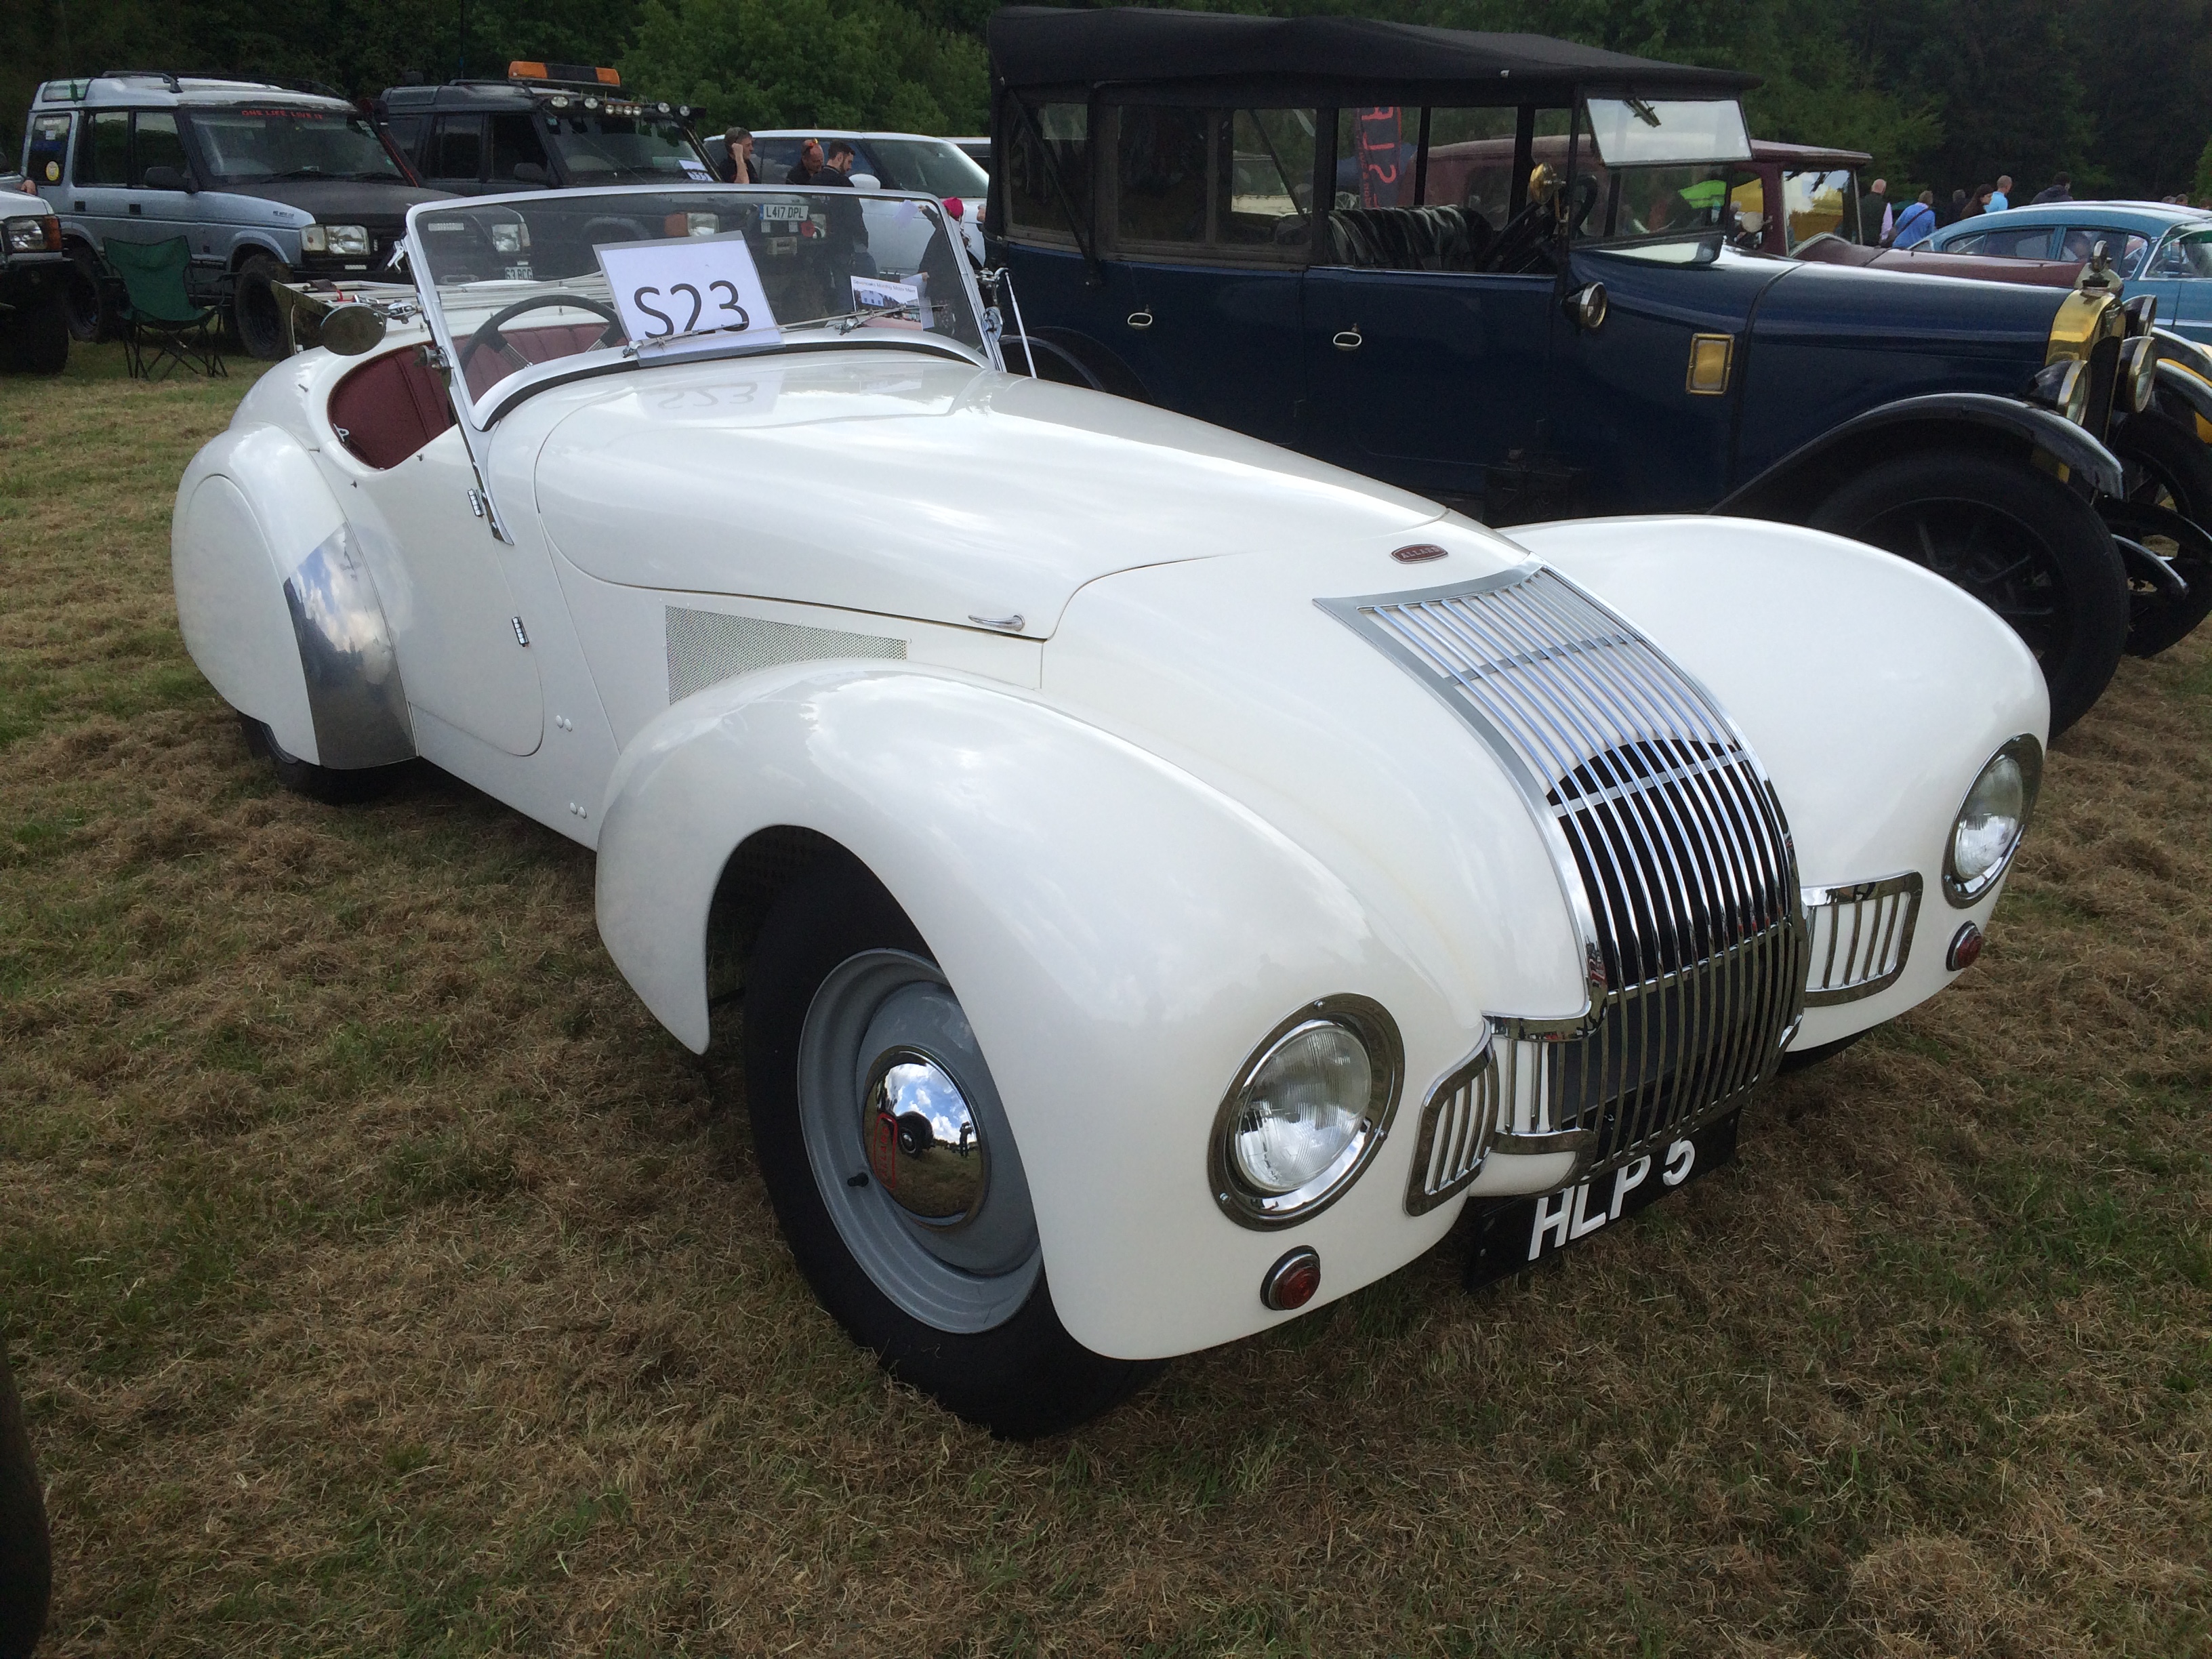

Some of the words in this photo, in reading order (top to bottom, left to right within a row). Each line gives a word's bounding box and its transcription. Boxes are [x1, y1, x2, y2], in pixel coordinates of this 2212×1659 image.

[766, 206, 785, 218] L417
[787, 207, 804, 219] DPL
[634, 280, 750, 338] S23
[1401, 547, 1440, 559] ALLARD
[1528, 1155, 1652, 1261] HLP
[1662, 1136, 1696, 1186] 5
